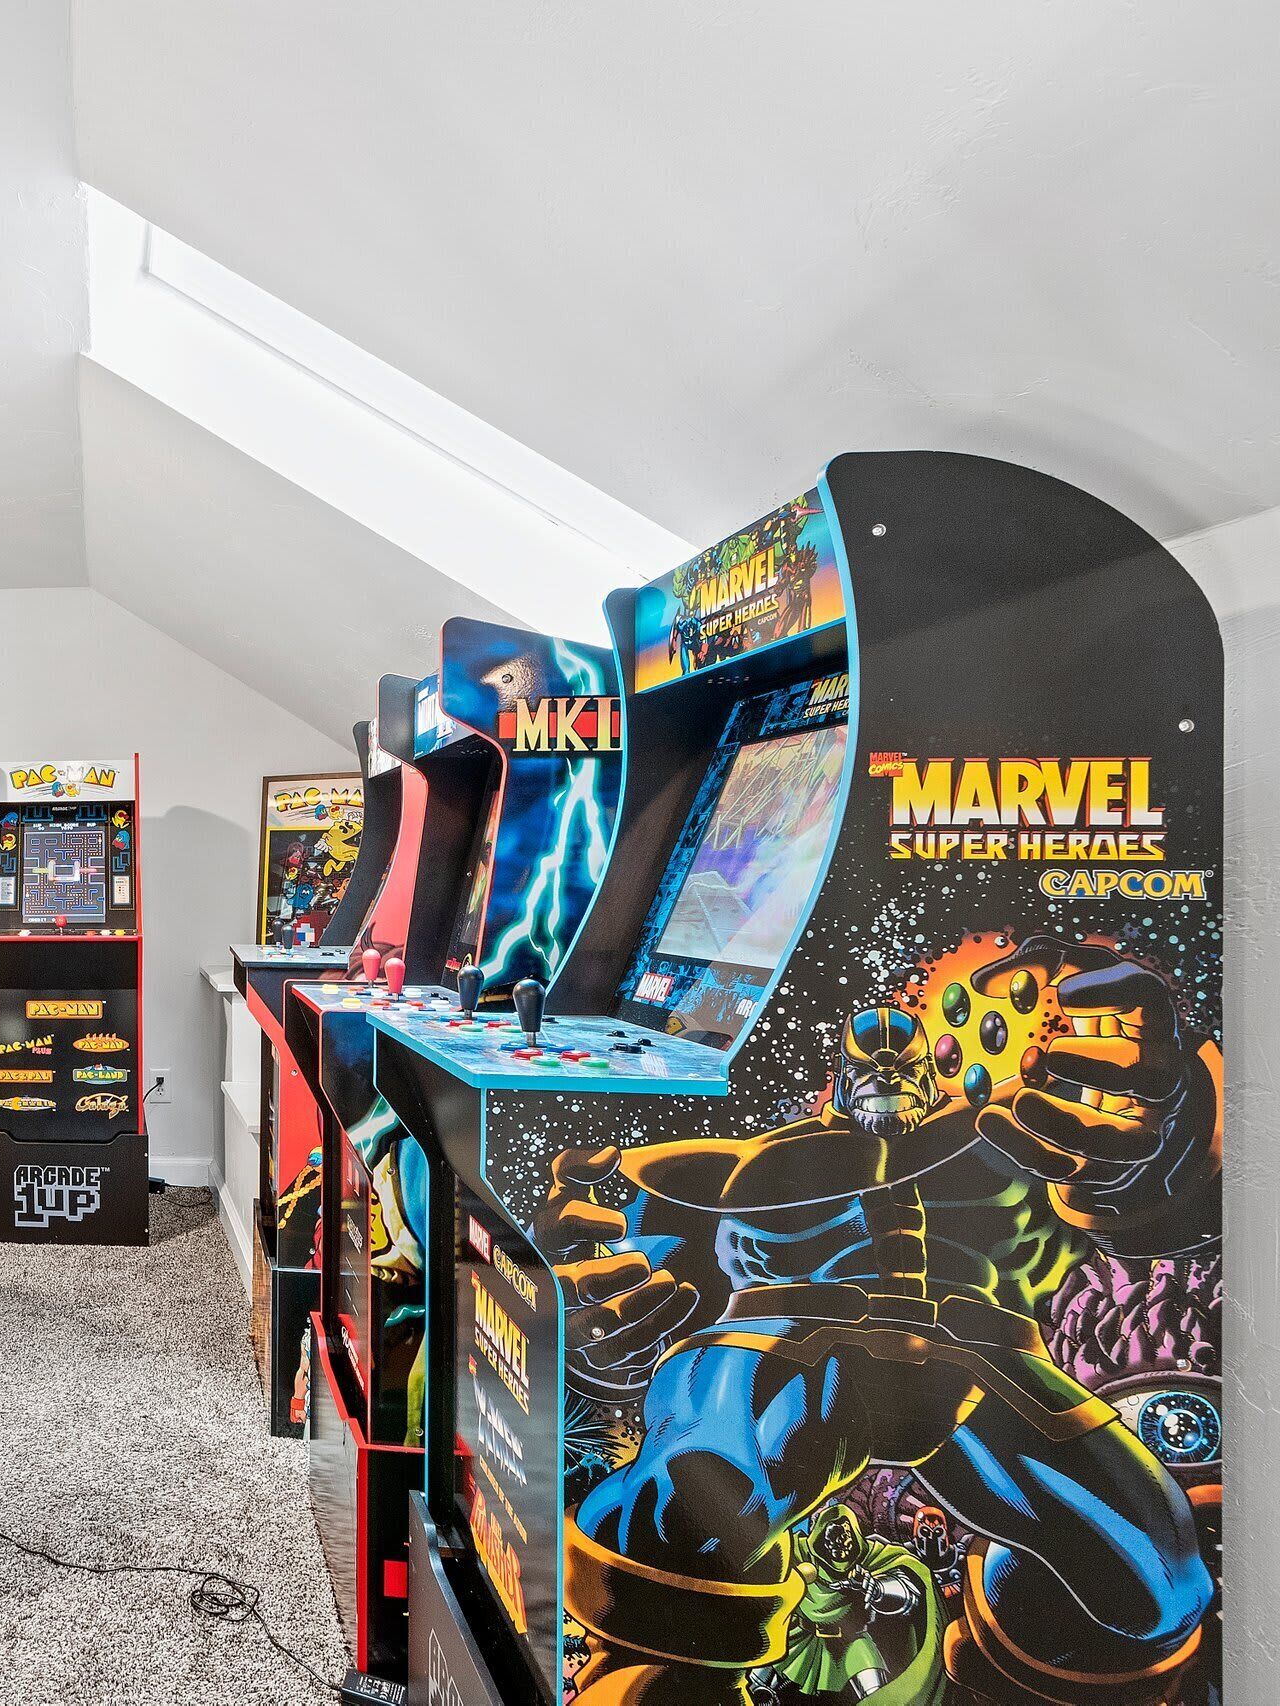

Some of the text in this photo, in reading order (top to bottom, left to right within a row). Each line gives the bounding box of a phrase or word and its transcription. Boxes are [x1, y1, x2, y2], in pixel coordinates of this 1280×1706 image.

[696, 547, 778, 618] MARVEL
[700, 594, 779, 640] SUPER HEROES
[758, 613, 778, 625] CAPCOM
[809, 674, 849, 705] MAR
[803, 703, 832, 718] SUPER
[831, 699, 849, 712] HER
[868, 762, 904, 775] COMICS
[870, 752, 902, 762] MARVEL
[9, 764, 116, 790] PAC-MAN
[890, 757, 1166, 827] MARVEL
[274, 787, 364, 812] PAC-MA
[889, 830, 1168, 861] SUPER HEROES
[1038, 868, 1206, 900] CAPCOM
[637, 973, 672, 1002] MARVEL
[30, 1003, 100, 1016] PAC-MAN
[76, 1071, 124, 1079] PAC-LAND
[15, 1165, 100, 1187] ARCADE
[15, 1182, 100, 1227] 1UP
[470, 1216, 490, 1262] MARVEL
[493, 1244, 538, 1312] CAPCOM
[475, 1280, 530, 1390] MARVEL
[475, 1326, 529, 1416] SUPER HEROES
